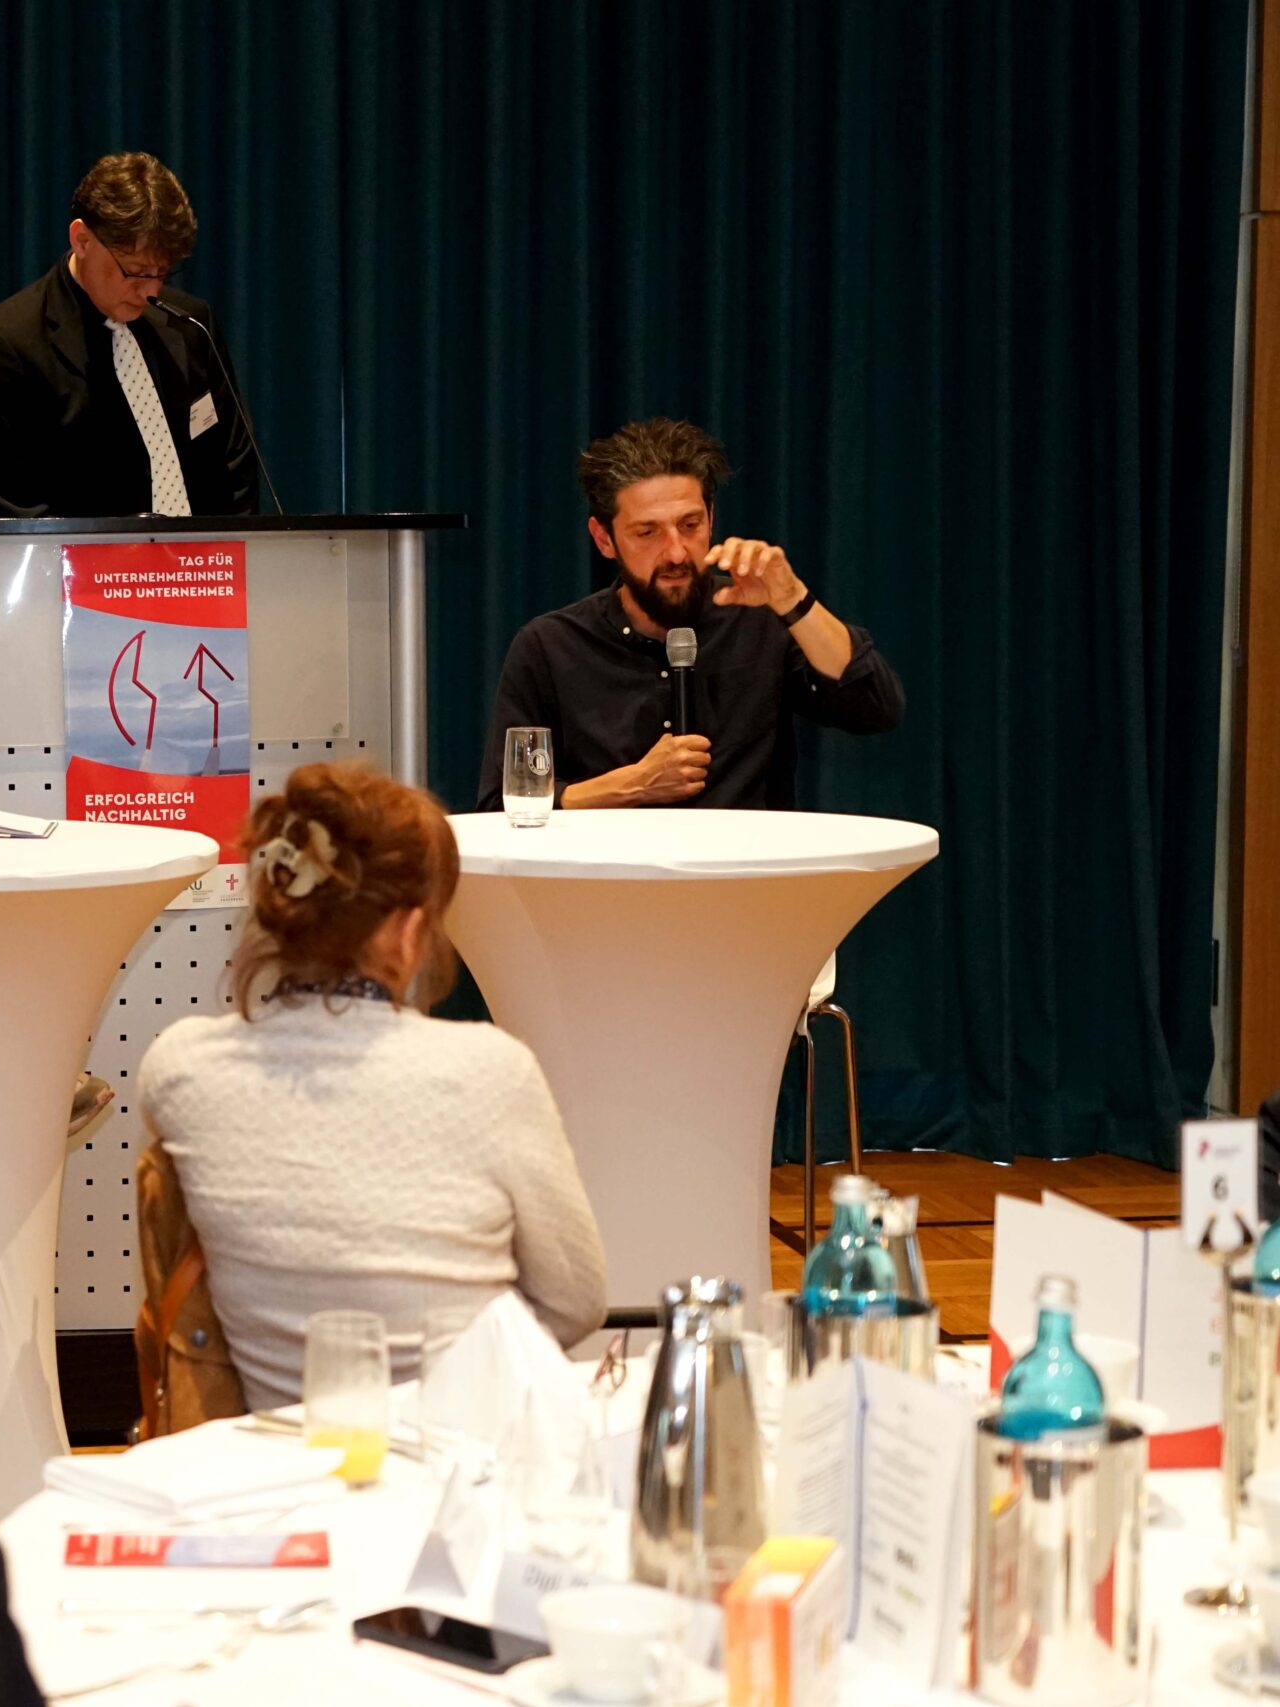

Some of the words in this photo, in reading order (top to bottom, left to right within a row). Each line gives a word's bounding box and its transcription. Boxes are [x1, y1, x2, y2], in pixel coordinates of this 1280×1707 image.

[179, 555, 205, 567] TAG
[208, 553, 233, 566] FÜR
[94, 571, 234, 584] UNTERNEHMERINNEN
[103, 588, 132, 599] UND
[136, 587, 234, 598] UNTERNEHMER
[85, 792, 195, 806] ERFOLGREICH
[85, 808, 187, 823] NACHHALTIG
[1211, 1176, 1229, 1202] 6
